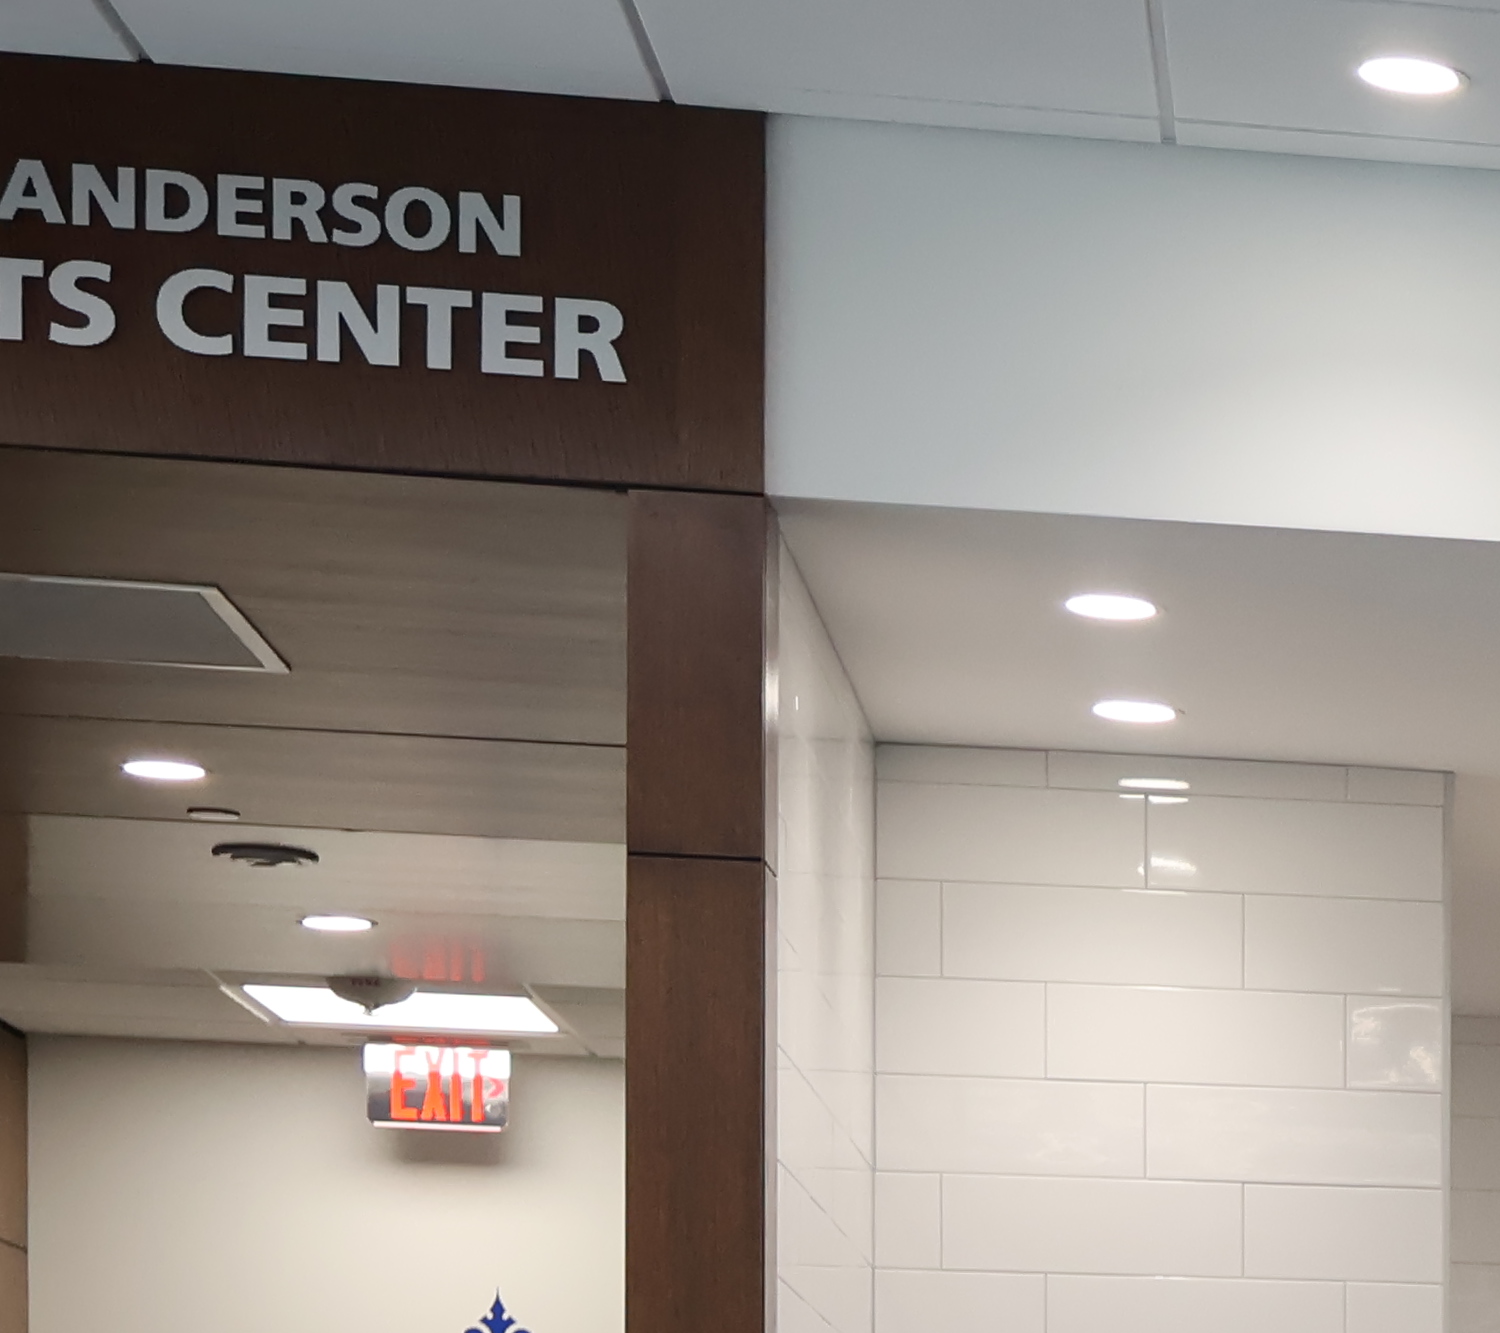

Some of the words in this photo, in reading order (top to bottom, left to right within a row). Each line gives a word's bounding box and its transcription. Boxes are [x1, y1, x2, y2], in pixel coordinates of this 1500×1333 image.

[0, 158, 522, 258] ANDERSON
[154, 267, 628, 385] CENTER
[390, 1046, 488, 1123] EXIT
